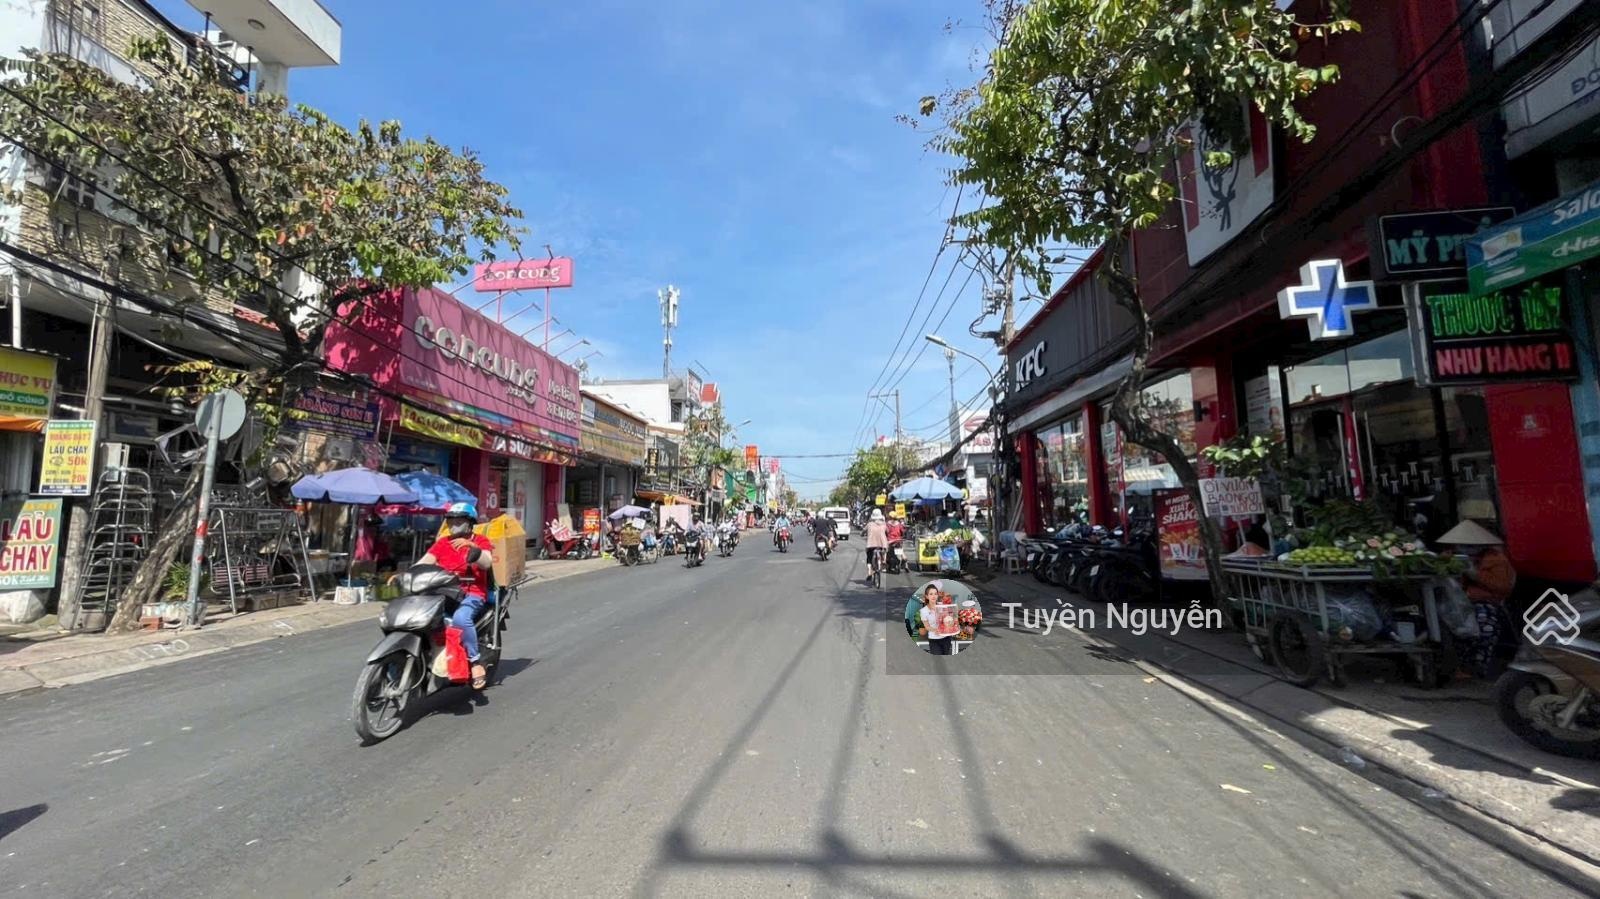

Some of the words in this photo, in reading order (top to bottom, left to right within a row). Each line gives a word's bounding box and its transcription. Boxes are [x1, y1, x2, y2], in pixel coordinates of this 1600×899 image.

[1015, 341, 1045, 392] KFC
[67, 445, 88, 454] CHAY
[0, 545, 52, 572] CHAY
